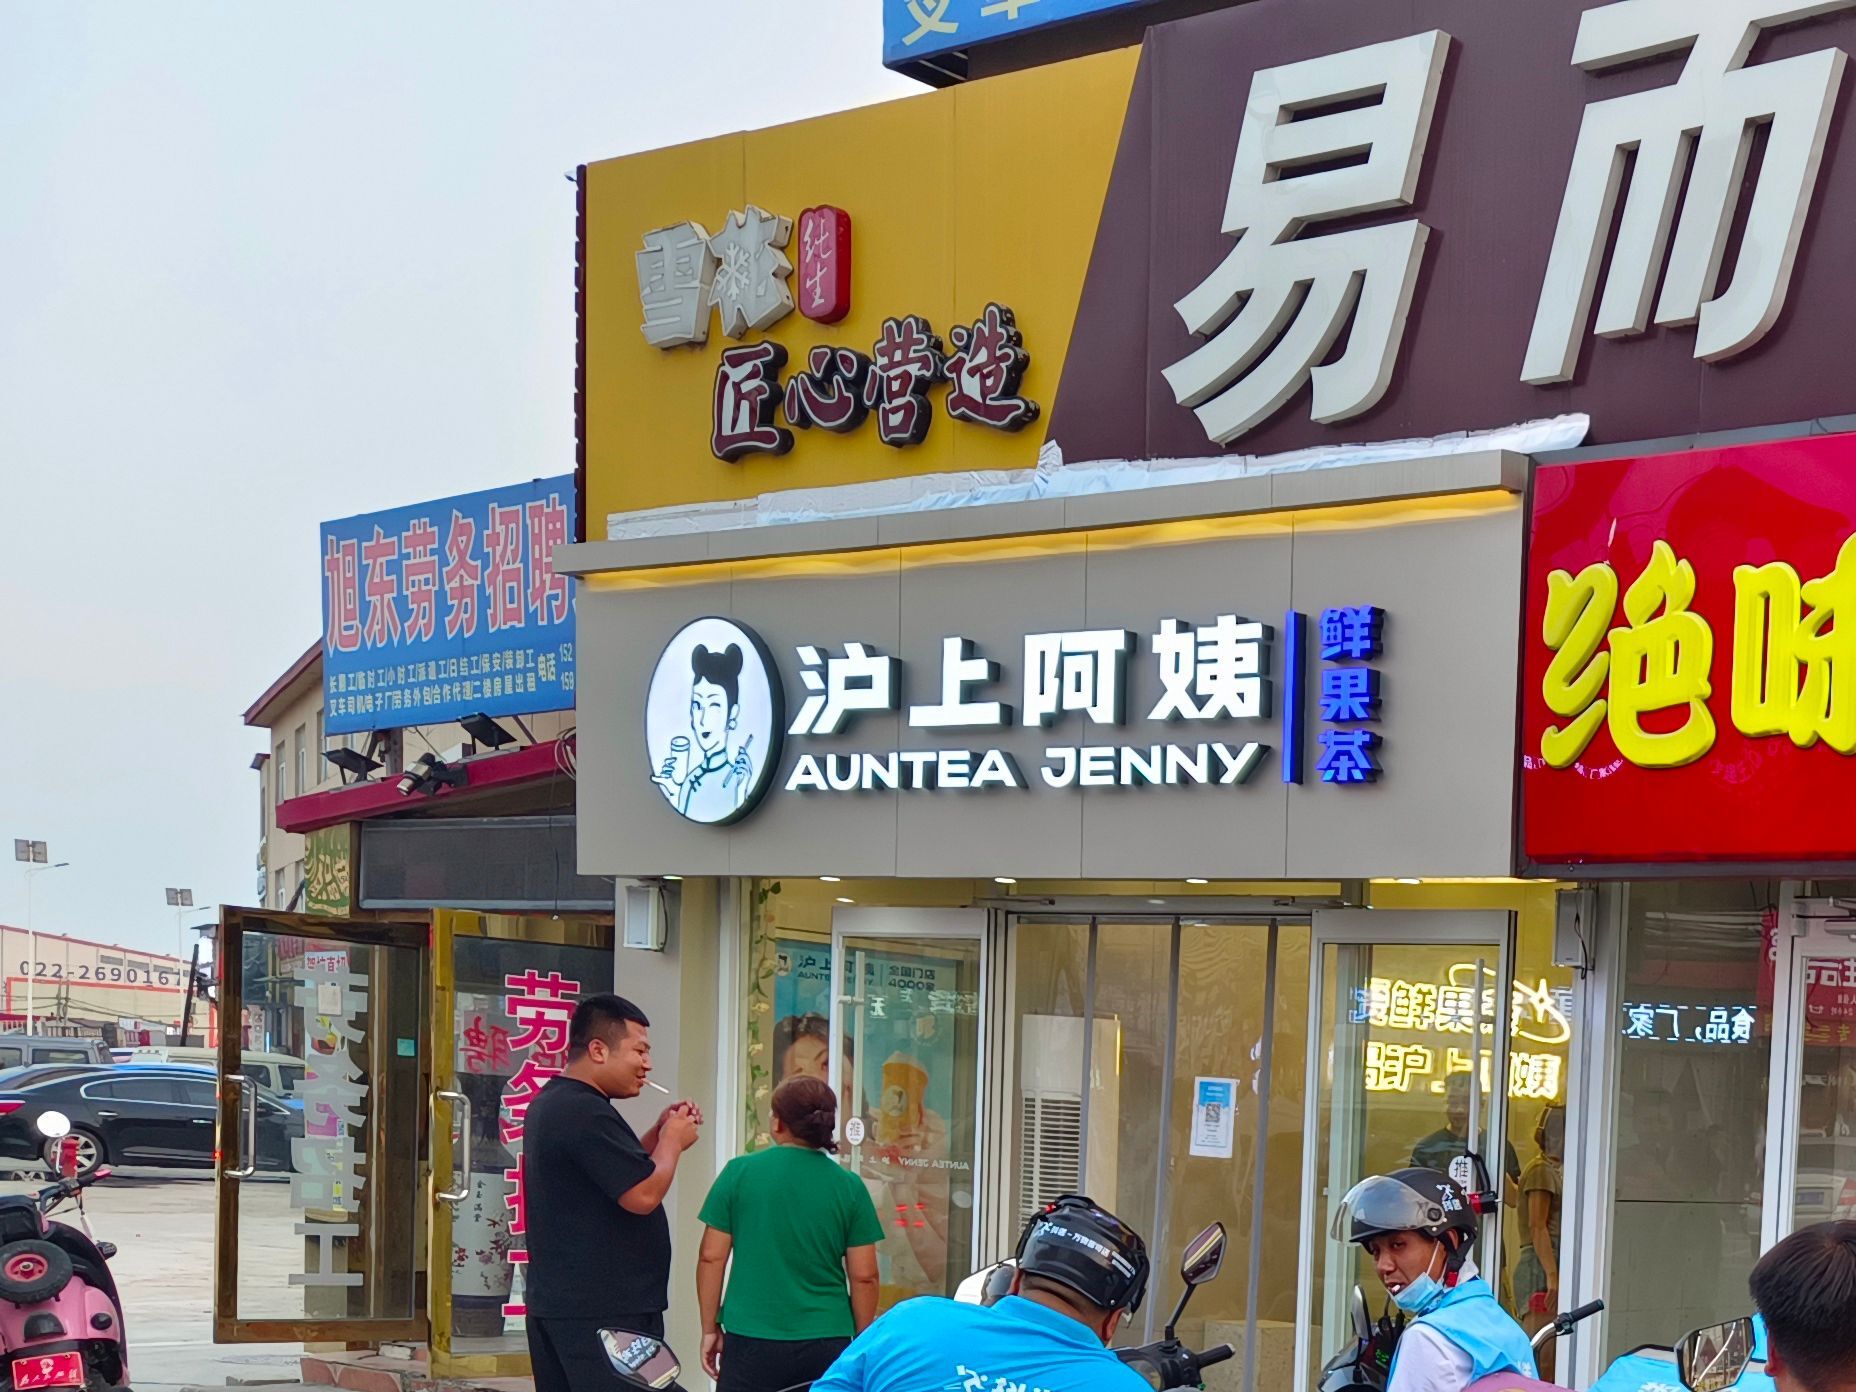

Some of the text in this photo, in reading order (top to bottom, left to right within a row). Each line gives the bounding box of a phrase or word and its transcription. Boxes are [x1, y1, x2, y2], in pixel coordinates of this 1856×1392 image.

[802, 214, 836, 311] 纯生
[712, 302, 1040, 463] 匠心营造
[325, 493, 568, 658] 旭东劳务招聘
[785, 613, 1276, 738] 沪上阿姨
[1317, 605, 1385, 785] 鲜果茶
[785, 741, 1270, 792] AUNTEA JENNY
